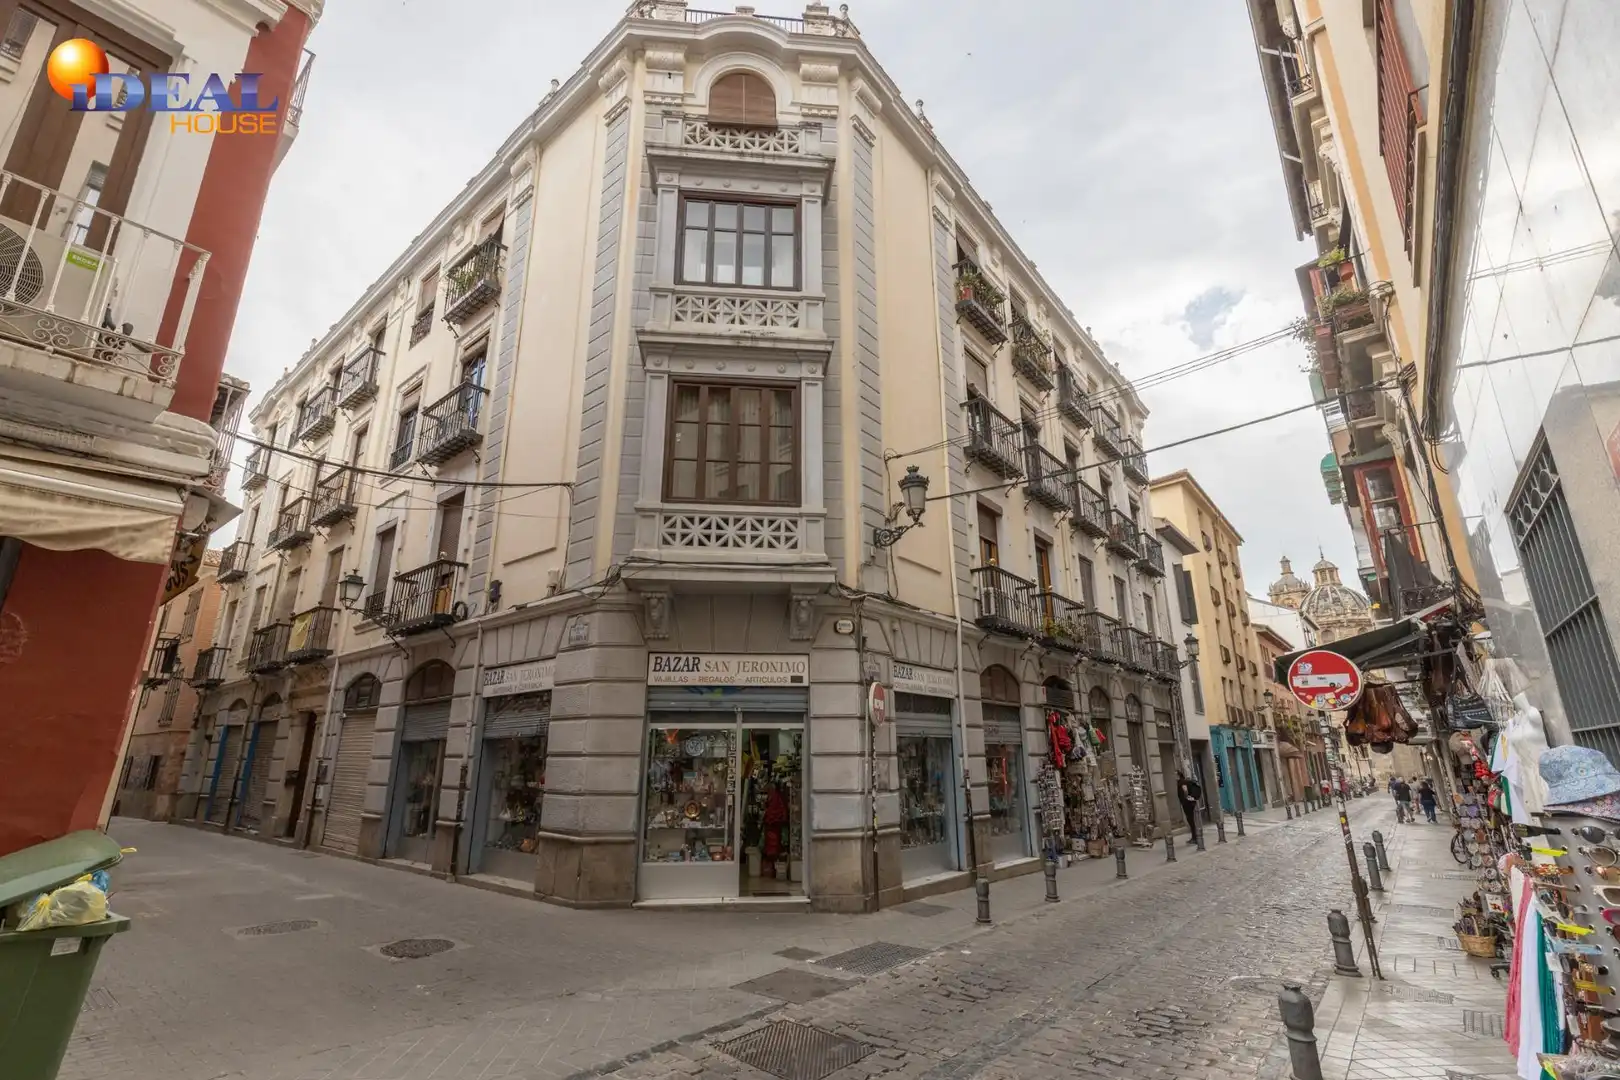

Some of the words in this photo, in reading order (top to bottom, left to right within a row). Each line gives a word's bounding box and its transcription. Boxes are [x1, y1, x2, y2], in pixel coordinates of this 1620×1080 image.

[652, 656, 701, 673] BAZAR
[703, 660, 731, 673] SAN
[735, 660, 806, 676] JERONIMO
[697, 675, 735, 684] REGALOS
[745, 675, 788, 684] ARTICULOS
